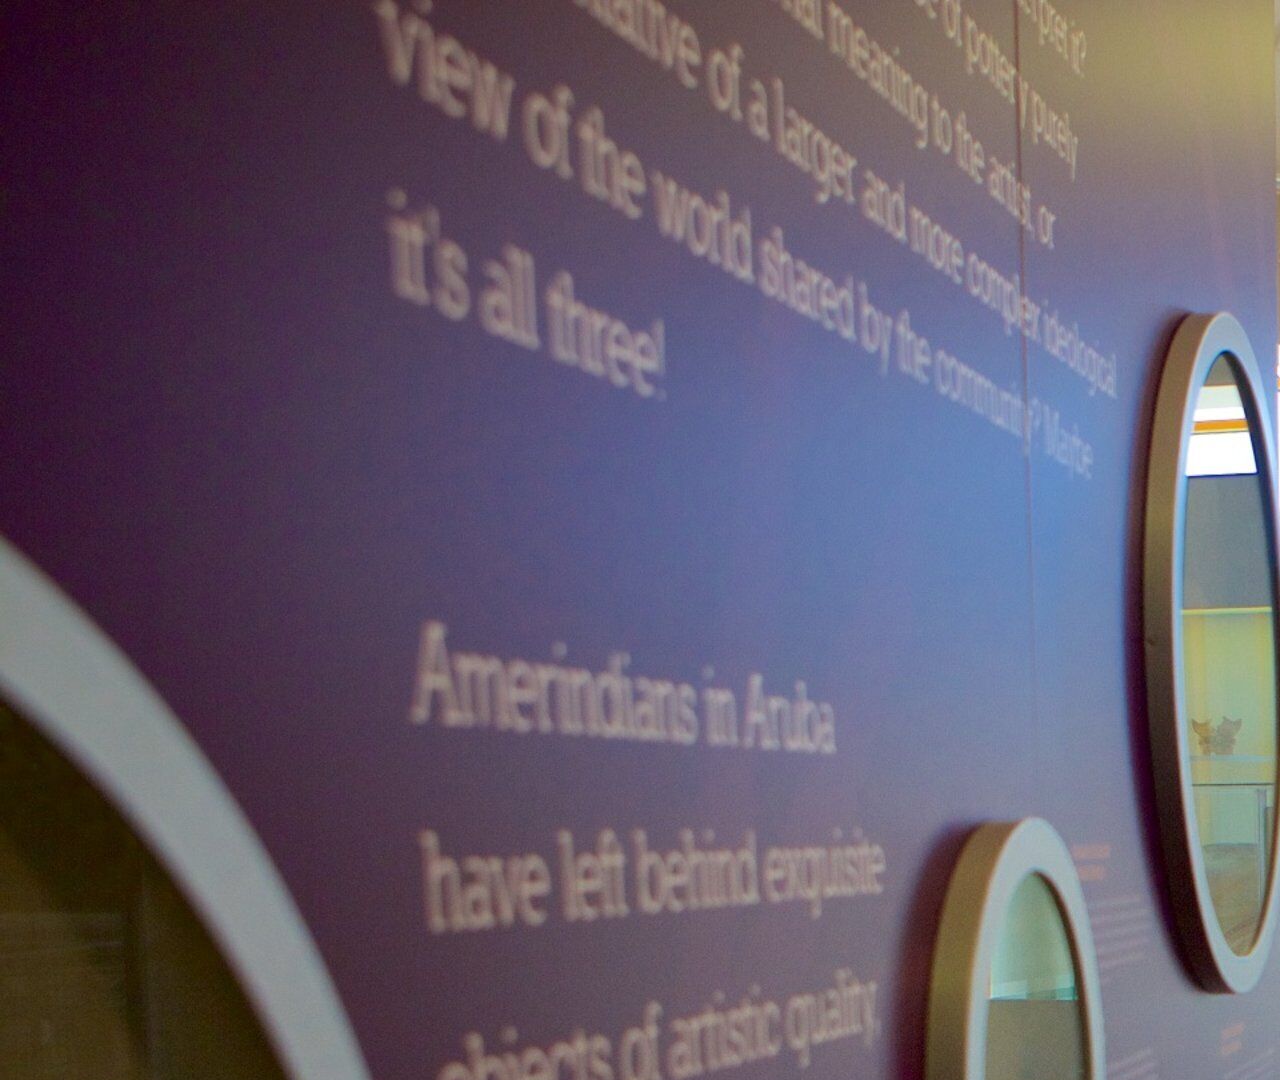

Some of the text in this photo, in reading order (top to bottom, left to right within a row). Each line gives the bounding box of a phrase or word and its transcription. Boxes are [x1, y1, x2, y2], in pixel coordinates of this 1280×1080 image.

[706, 42, 745, 122] of
[749, 78, 770, 142] a
[771, 76, 858, 205] larger
[860, 170, 907, 244] and
[908, 205, 965, 284] more
[966, 250, 1041, 342] complex
[1042, 298, 1119, 400] ideological
[827, 2, 930, 149] meaning
[933, 92, 953, 155] to
[954, 110, 986, 185] the
[1037, 204, 1057, 250] or
[1029, 88, 1079, 183] purely
[385, 187, 667, 402] it's all three!
[522, 84, 576, 181] of
[577, 105, 647, 220] the
[650, 170, 754, 285] world
[757, 226, 857, 342] shared
[858, 280, 894, 376] by
[895, 308, 933, 384] the
[408, 620, 838, 755] Amerindians in Aruba
[417, 825, 887, 935] have left behind exquisite
